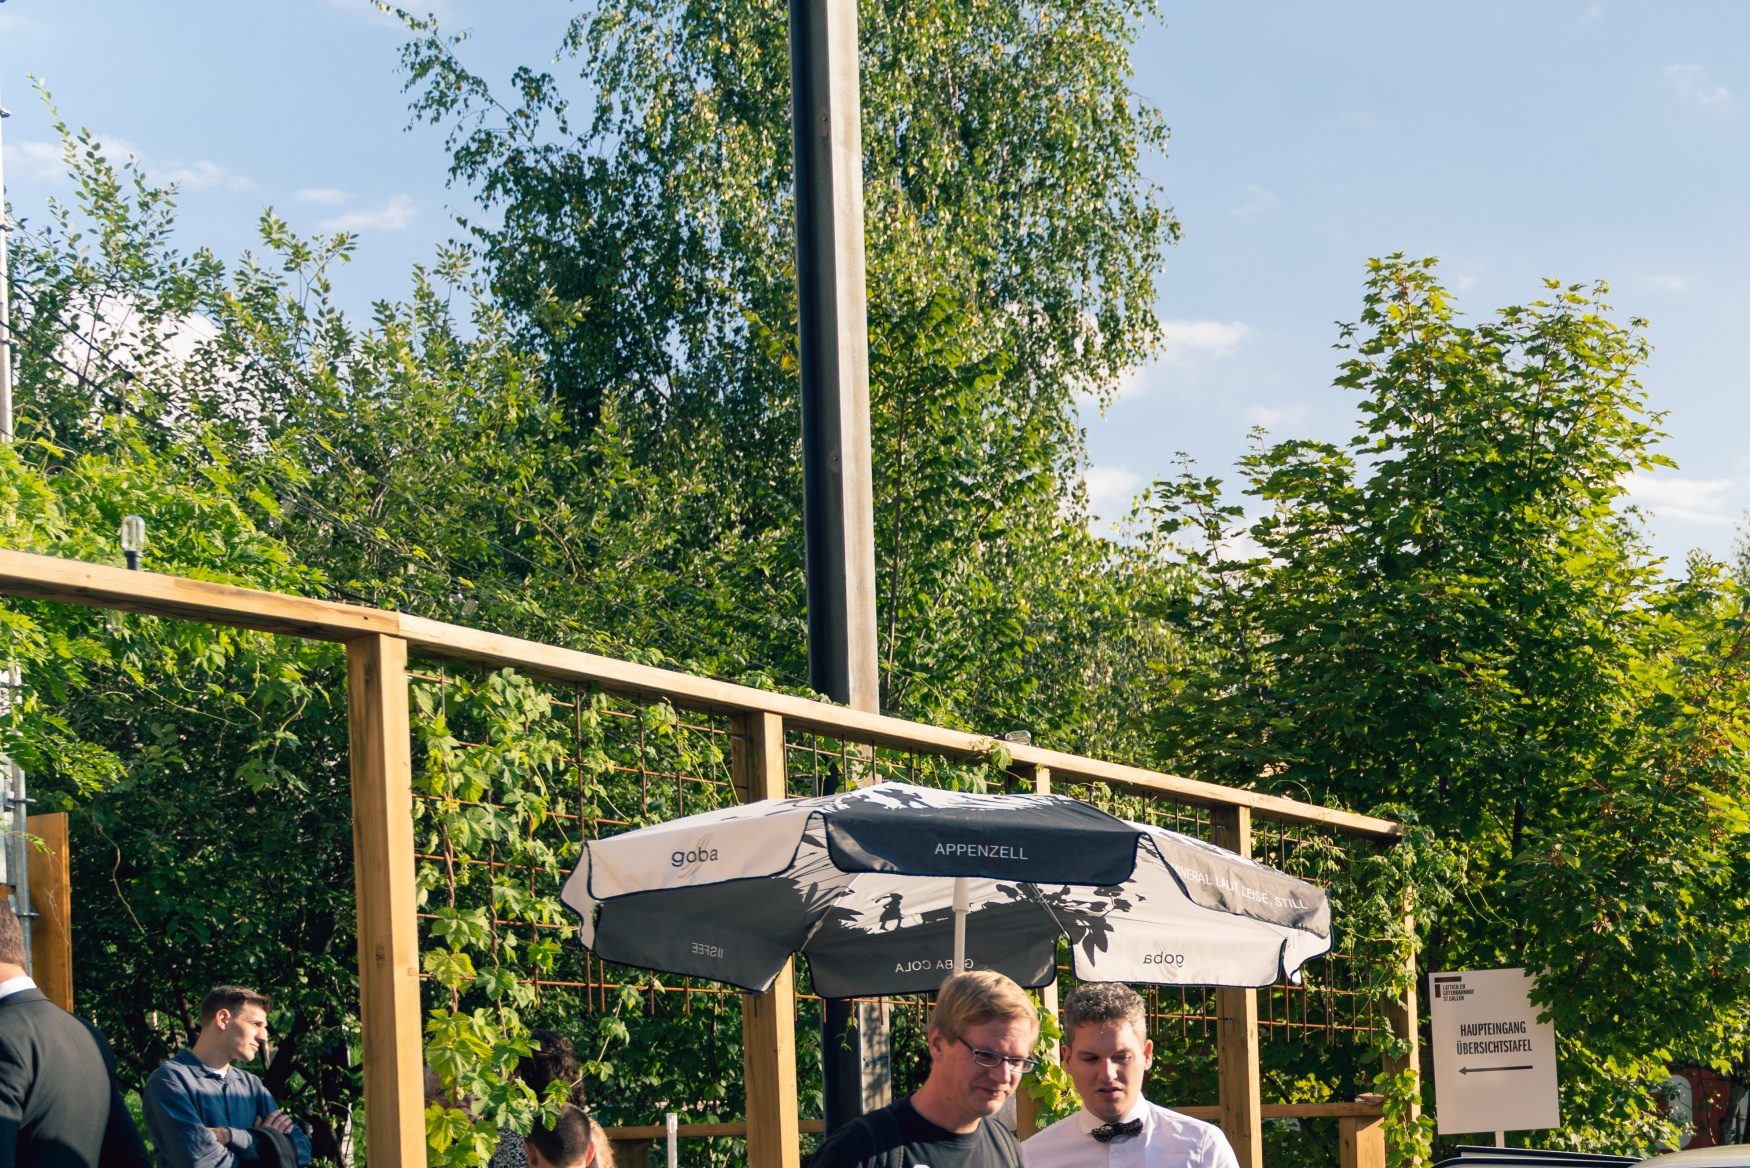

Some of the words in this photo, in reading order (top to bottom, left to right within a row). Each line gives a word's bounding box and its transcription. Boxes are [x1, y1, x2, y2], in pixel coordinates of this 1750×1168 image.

[671, 846, 719, 867] goba
[934, 842, 1029, 860] APPENZELL
[1241, 887, 1273, 906] LEISE,
[1275, 897, 1309, 910] STILL
[1460, 1021, 1527, 1037] HAUPTEINGANG
[1456, 1039, 1533, 1055] ÜBERSICHTSTAFEL
